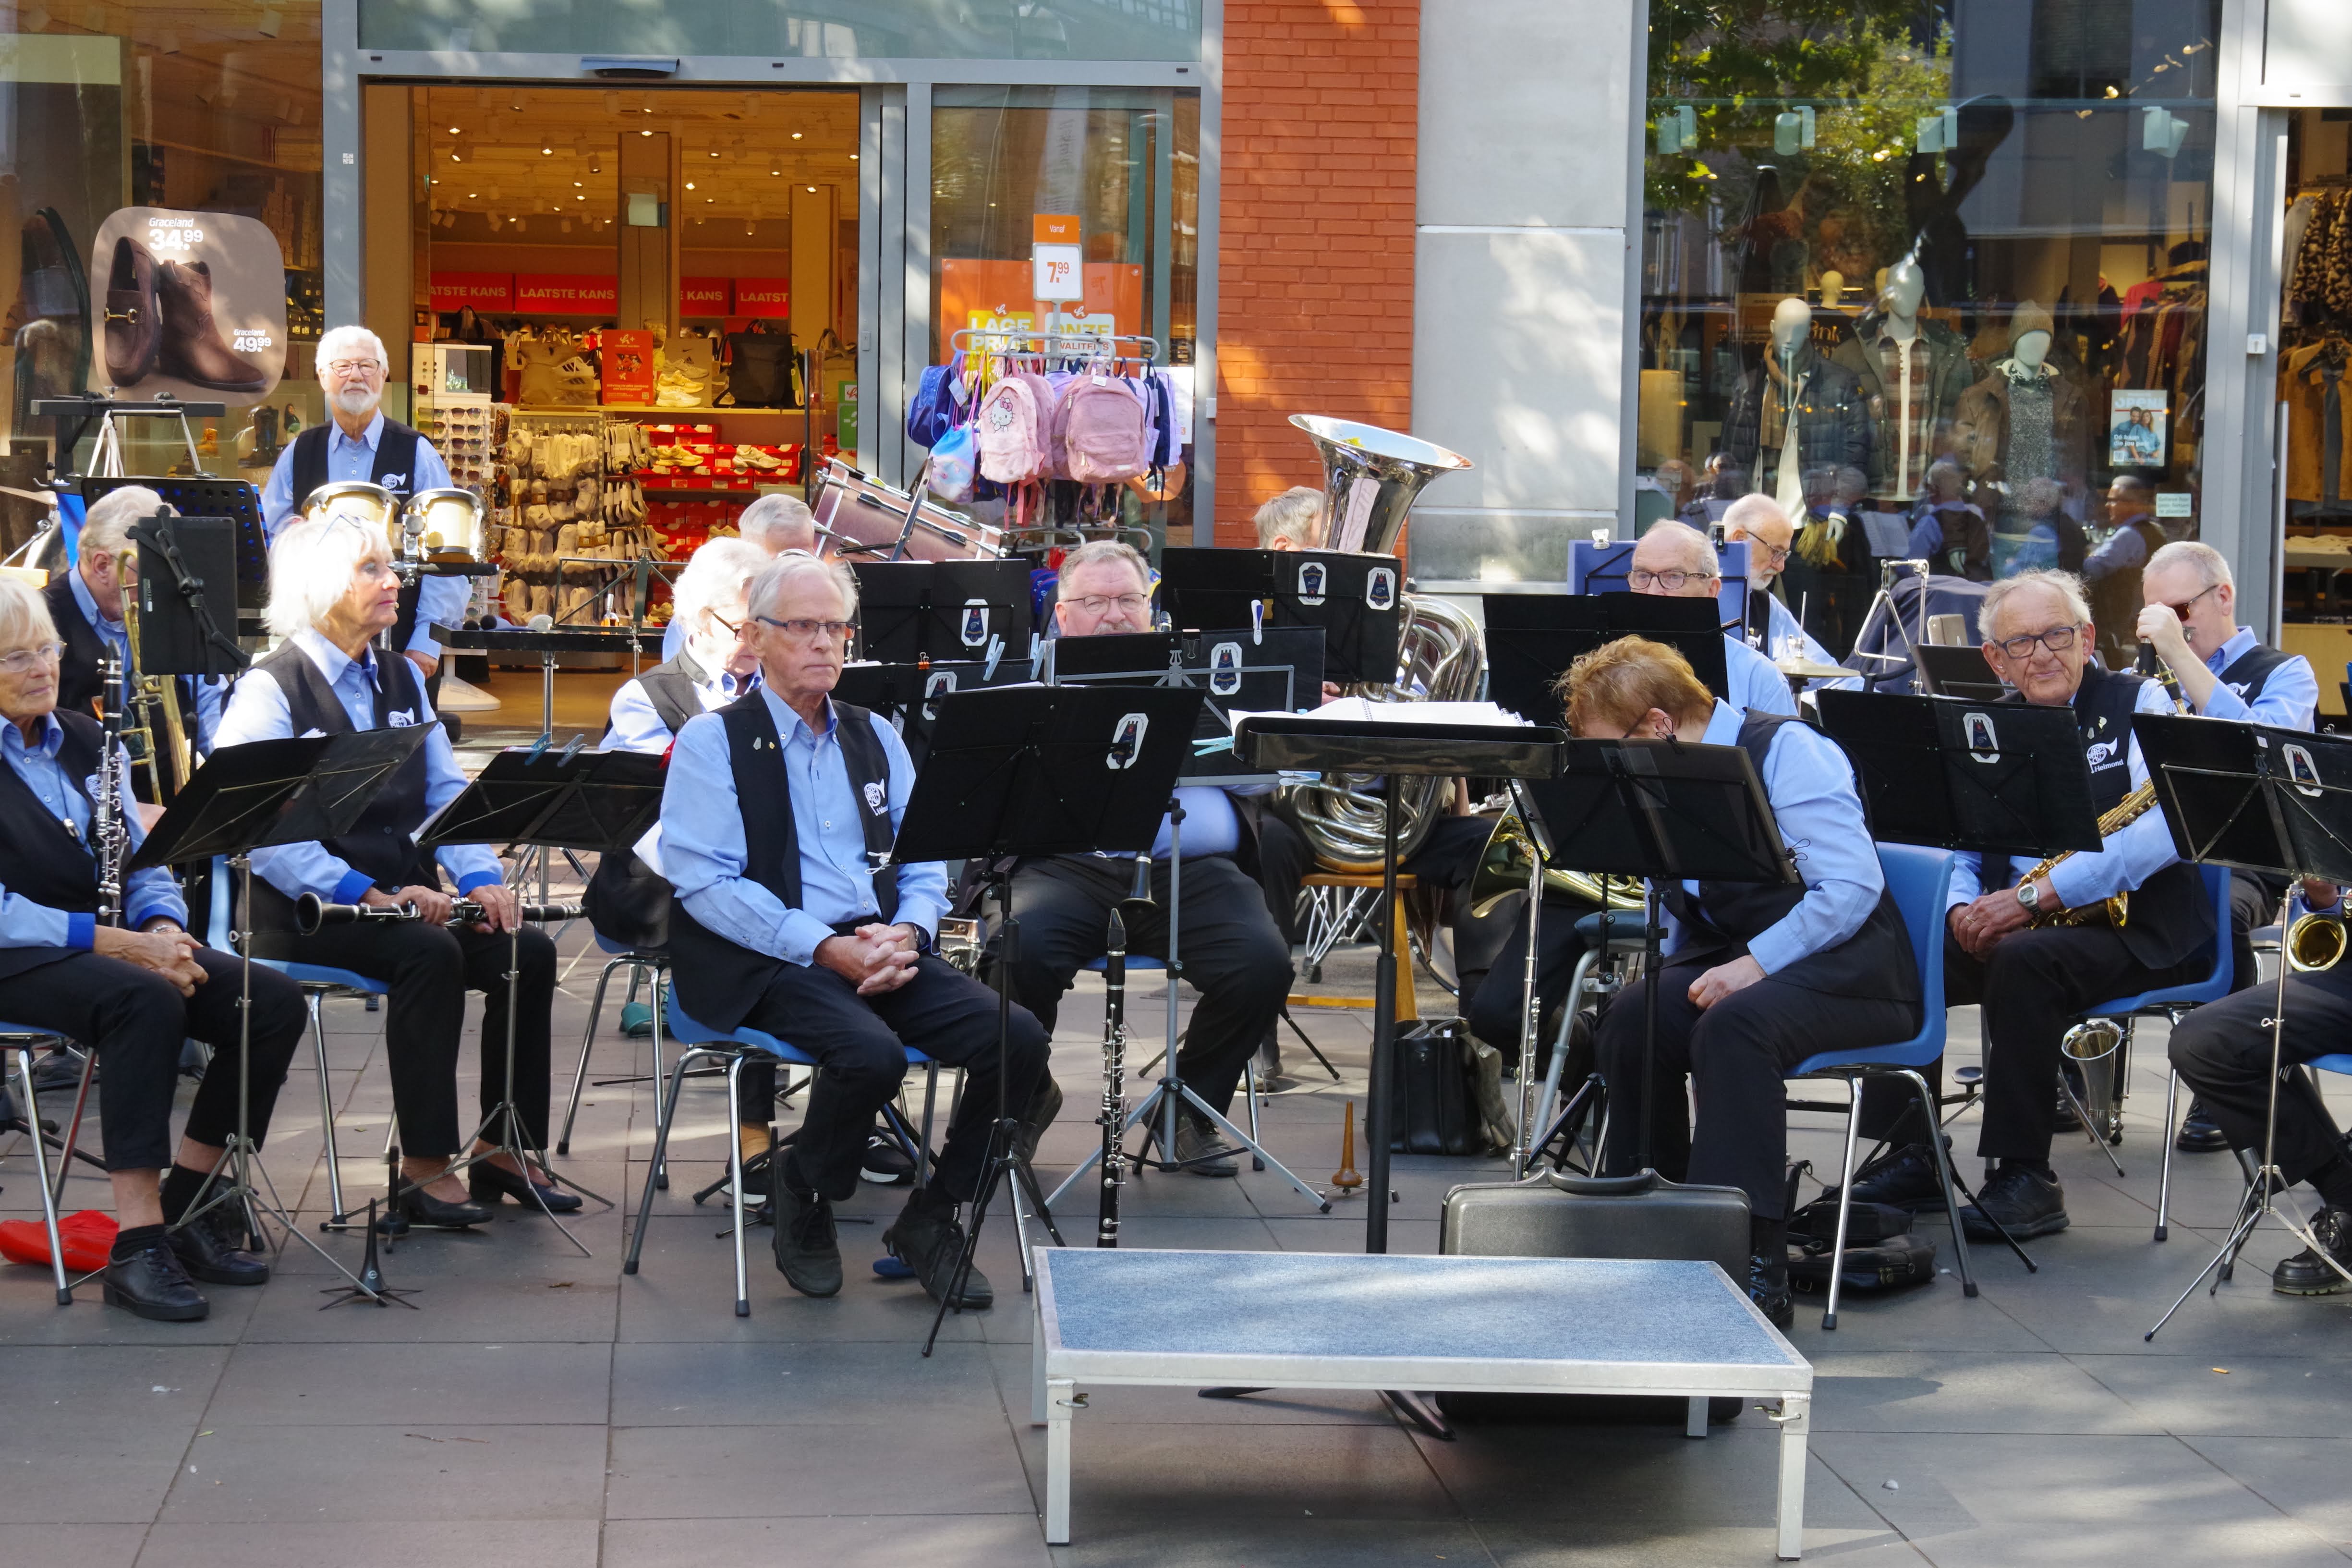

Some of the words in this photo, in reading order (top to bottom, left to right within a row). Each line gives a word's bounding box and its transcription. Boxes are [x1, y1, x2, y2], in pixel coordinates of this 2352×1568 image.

[149, 218, 194, 227] Graceland
[1049, 224, 1066, 233] Vanaf
[149, 229, 204, 250] 34.99
[1047, 262, 1069, 283] 7.99
[471, 287, 506, 296] KANS
[520, 288, 575, 298] LAATSTE
[579, 290, 615, 299] KANS
[687, 291, 723, 301] KANS
[740, 292, 788, 303] LAATST
[233, 337, 272, 352] 49.99
[2094, 758, 2124, 772] Helmond
